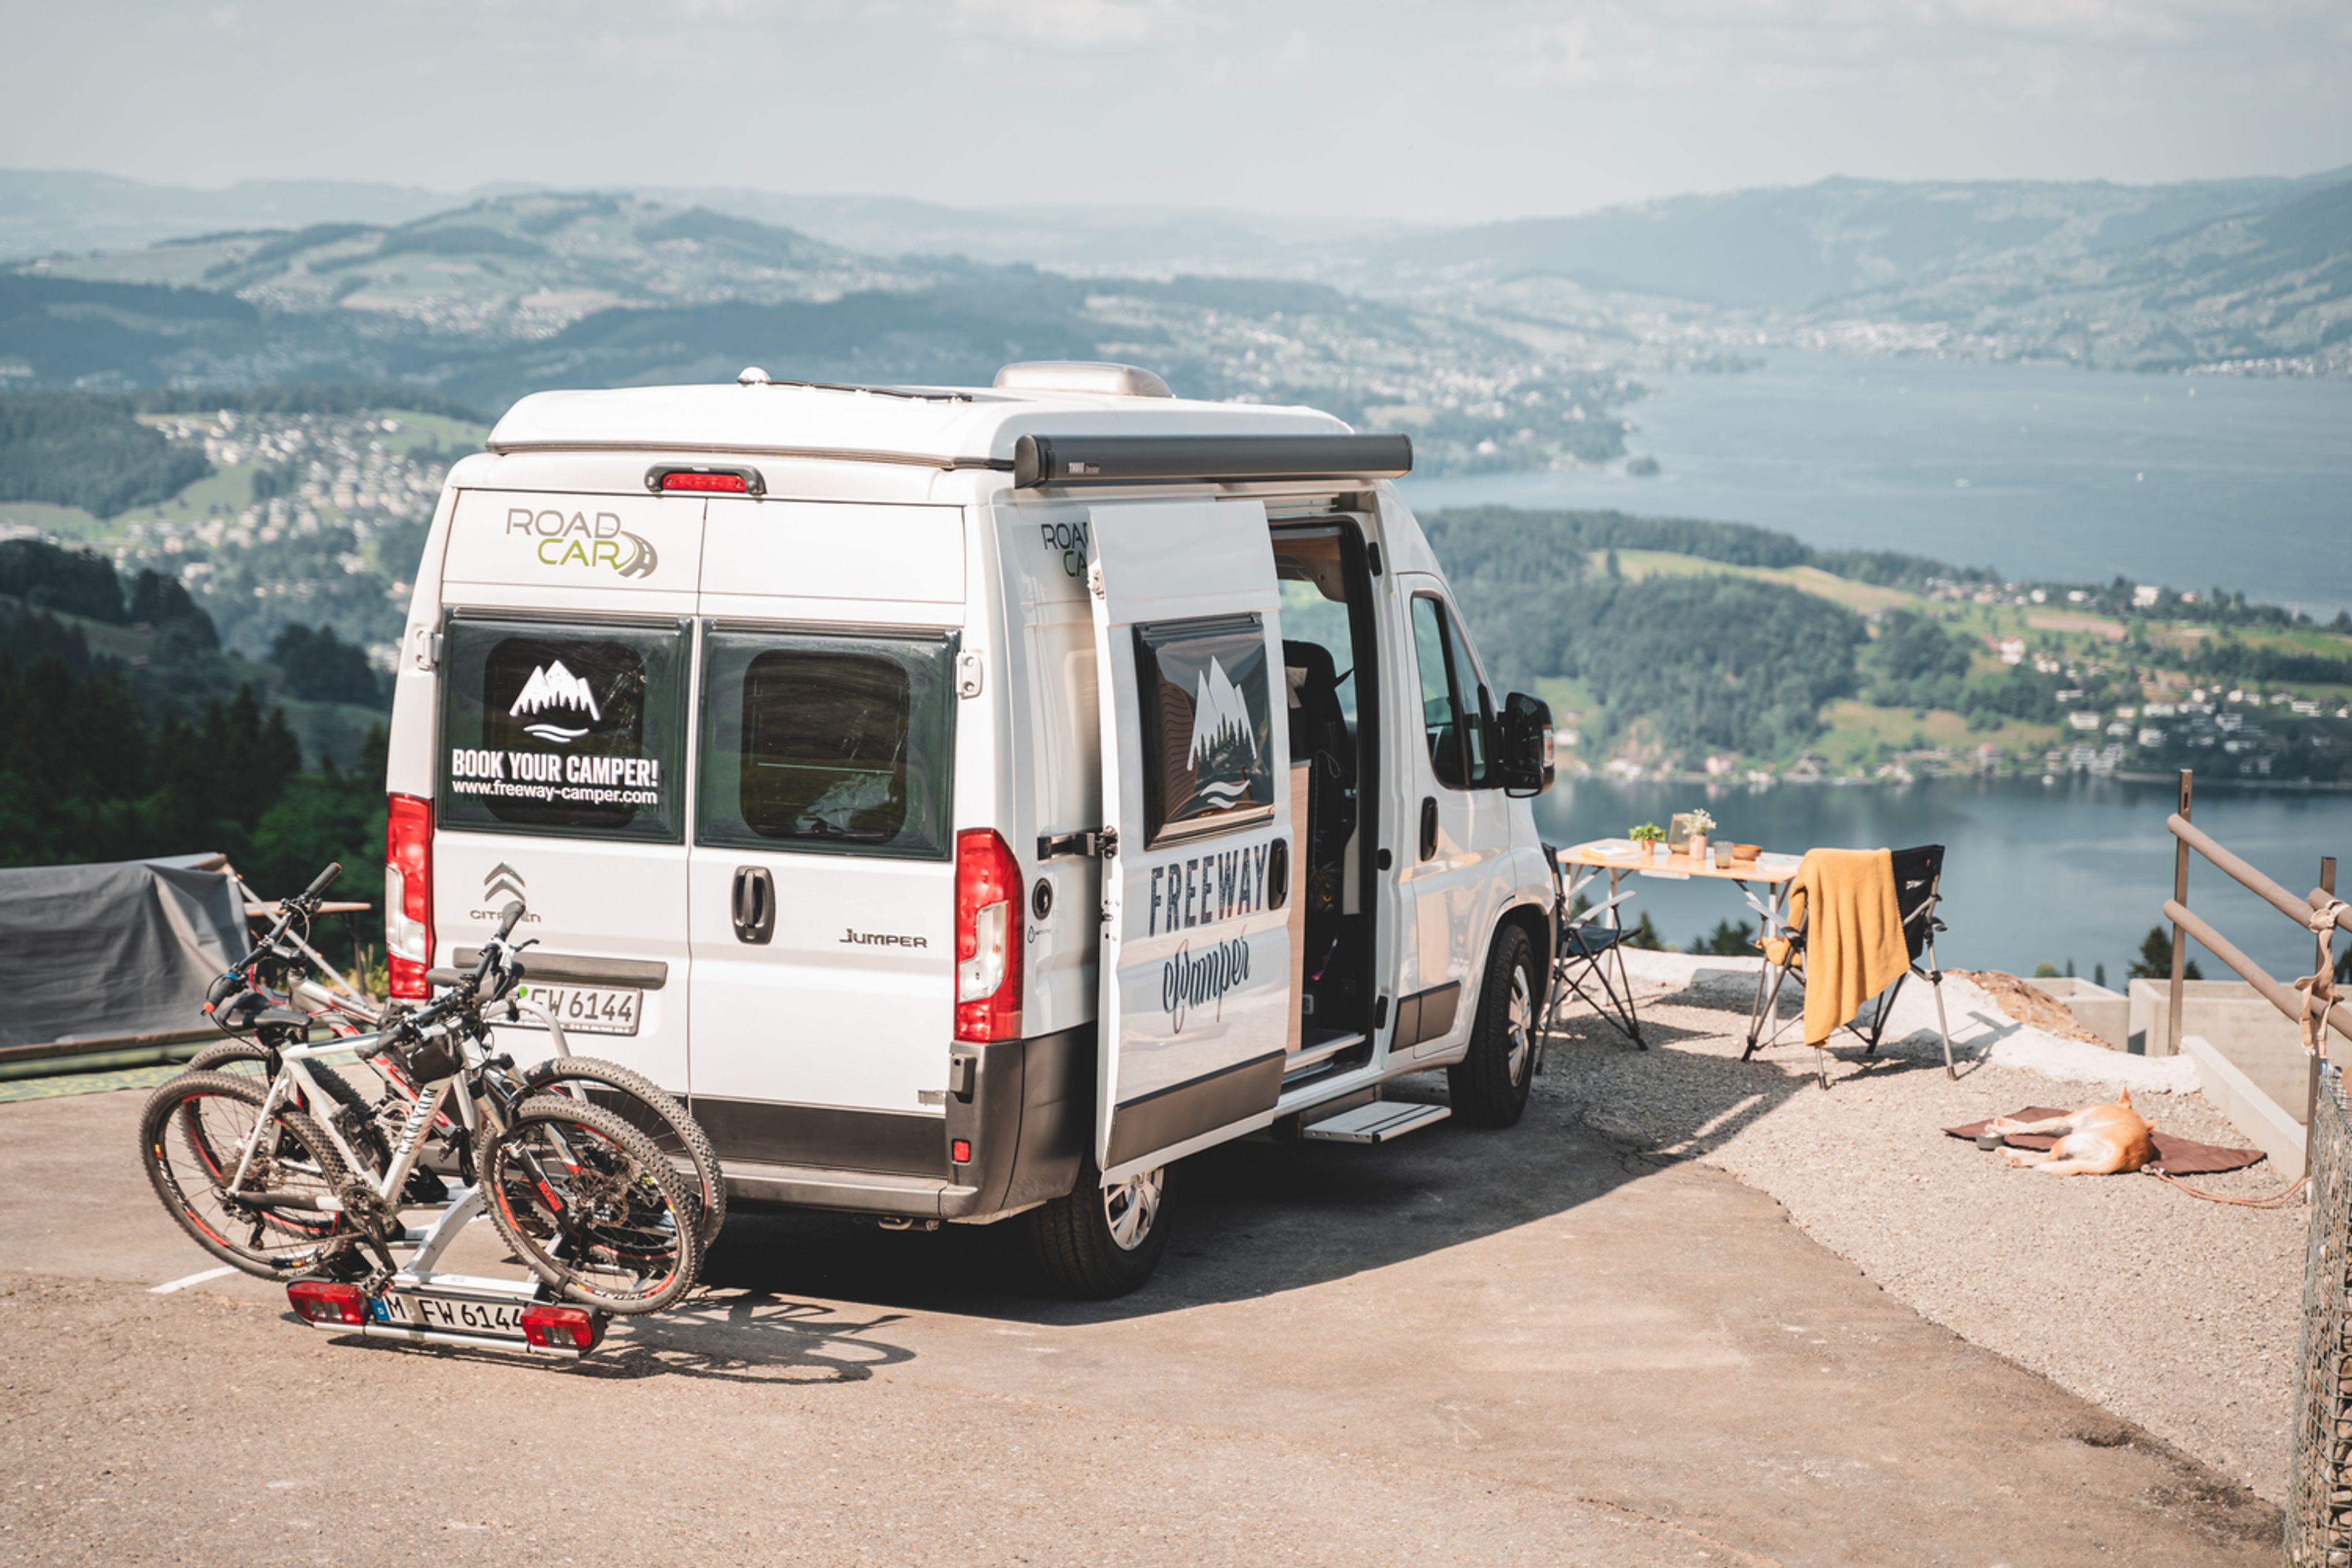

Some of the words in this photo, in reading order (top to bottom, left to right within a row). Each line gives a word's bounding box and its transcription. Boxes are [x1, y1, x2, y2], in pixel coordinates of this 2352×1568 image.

[507, 508, 620, 538] ROAD
[538, 538, 620, 570] CAR
[1063, 550, 1087, 577] CA
[452, 748, 505, 778] BOOK
[506, 752, 562, 782] YOUR
[566, 755, 658, 787] CAMPER!
[451, 779, 658, 805] www.freeway-camper.com
[1150, 843, 1268, 937] FREEWAY
[470, 910, 541, 922] CITRN
[569, 990, 633, 1022] 6144
[398, 1087, 439, 1155] CANYON
[385, 1295, 407, 1319] M
[418, 1299, 455, 1324] FW
